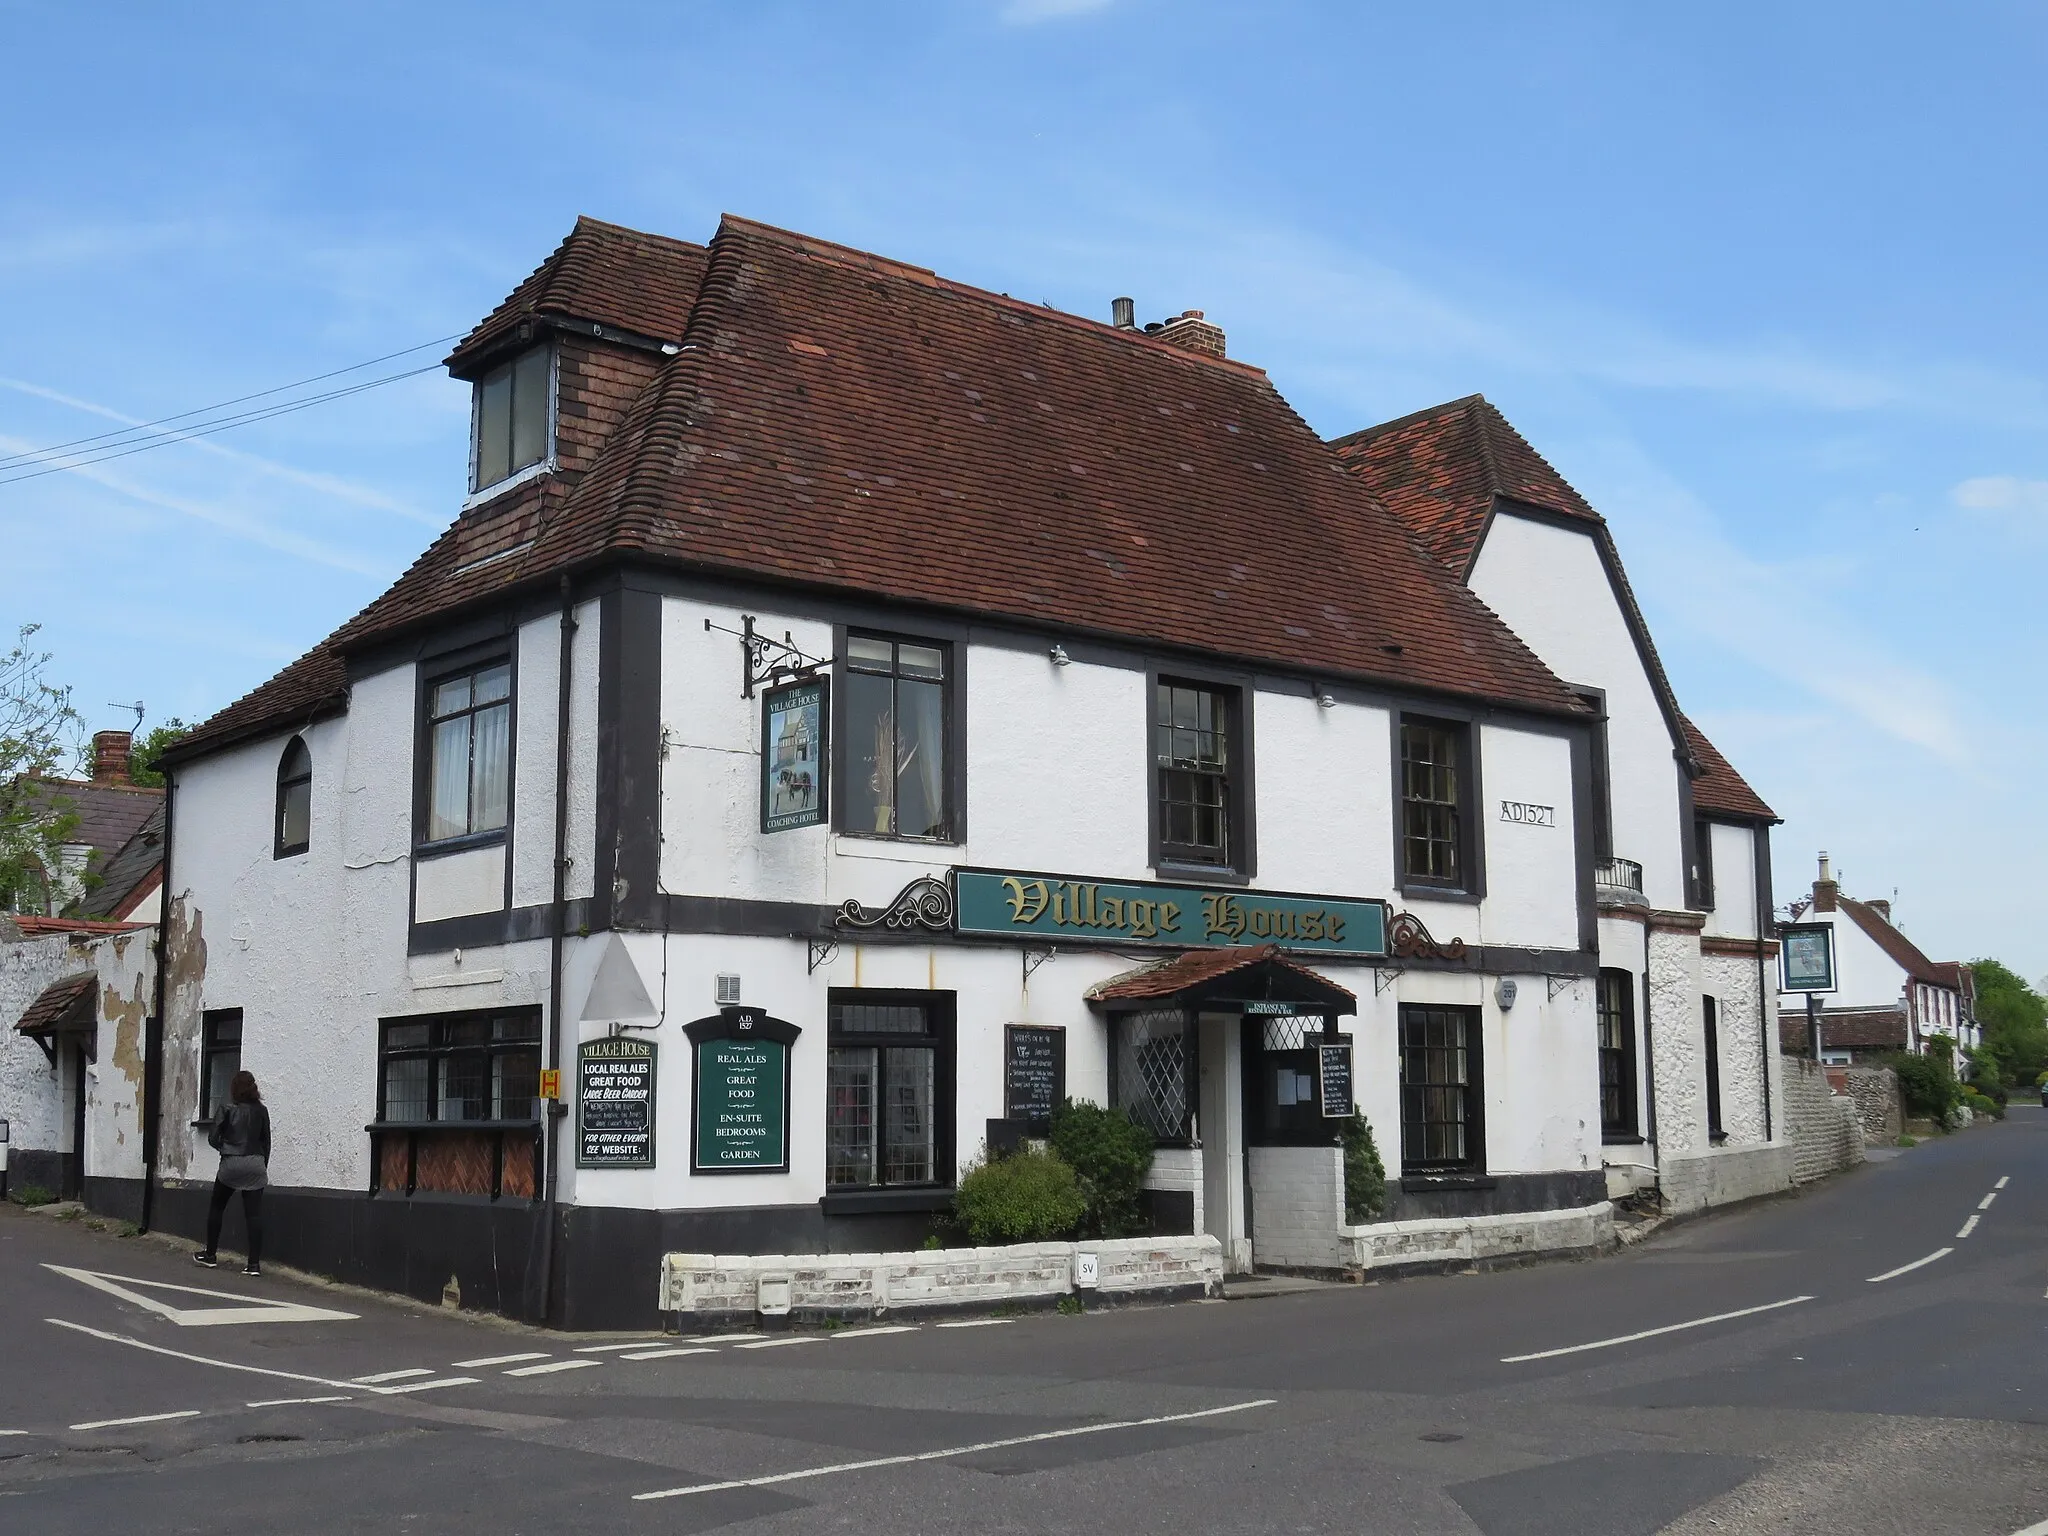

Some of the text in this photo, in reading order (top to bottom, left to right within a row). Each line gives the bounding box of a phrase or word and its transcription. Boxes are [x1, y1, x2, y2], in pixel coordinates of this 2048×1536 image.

[788, 688, 802, 699] THE
[770, 693, 819, 712] VILLAGE HOUSE
[767, 812, 820, 828] COACHING HOTEL
[1001, 876, 1346, 944] Village House
[738, 1015, 753, 1023] A.D.
[739, 1022, 753, 1030] 1527
[583, 1041, 651, 1057] VILLAGE HOUSE
[717, 1055, 767, 1064] REAL ALES
[584, 1064, 648, 1075] LOCAL REAL ALES
[542, 1072, 558, 1097] H
[589, 1076, 642, 1087] GREAT FOOD
[726, 1076, 757, 1085] GREAT
[583, 1088, 649, 1100] LARGE BEER GARDEN
[728, 1089, 755, 1098] FOOD
[720, 1114, 763, 1123] EN-SUITE
[716, 1127, 767, 1137] BEDROOMS
[584, 1133, 649, 1143] FOR OTHER EVENTS
[586, 1145, 642, 1154] SEE WEBSITE:
[720, 1150, 761, 1159] GARDEN
[1082, 1263, 1094, 1274] SV
